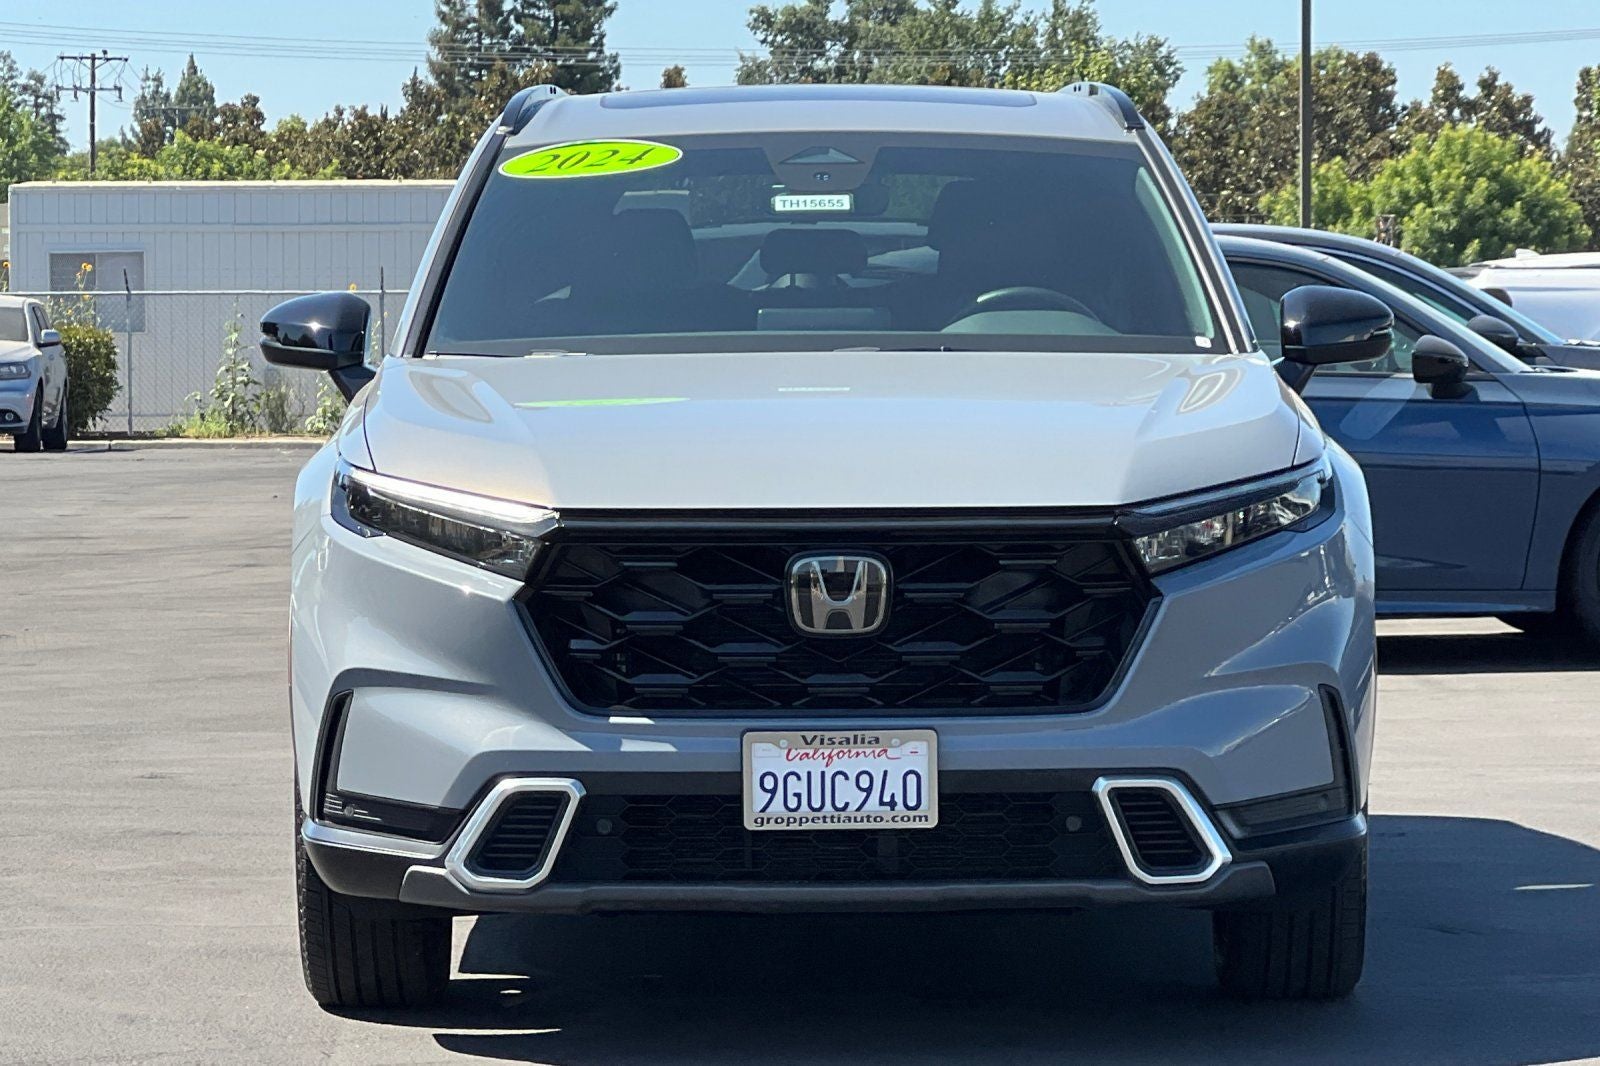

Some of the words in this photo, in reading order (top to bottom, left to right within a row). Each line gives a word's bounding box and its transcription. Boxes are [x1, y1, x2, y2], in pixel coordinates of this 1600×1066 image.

[527, 146, 655, 173] 2024
[779, 198, 844, 210] TH15655
[800, 734, 880, 746] Visalia
[786, 748, 902, 767] California
[759, 770, 922, 813] 9GUC940
[754, 814, 929, 828] groppettiauto.com
